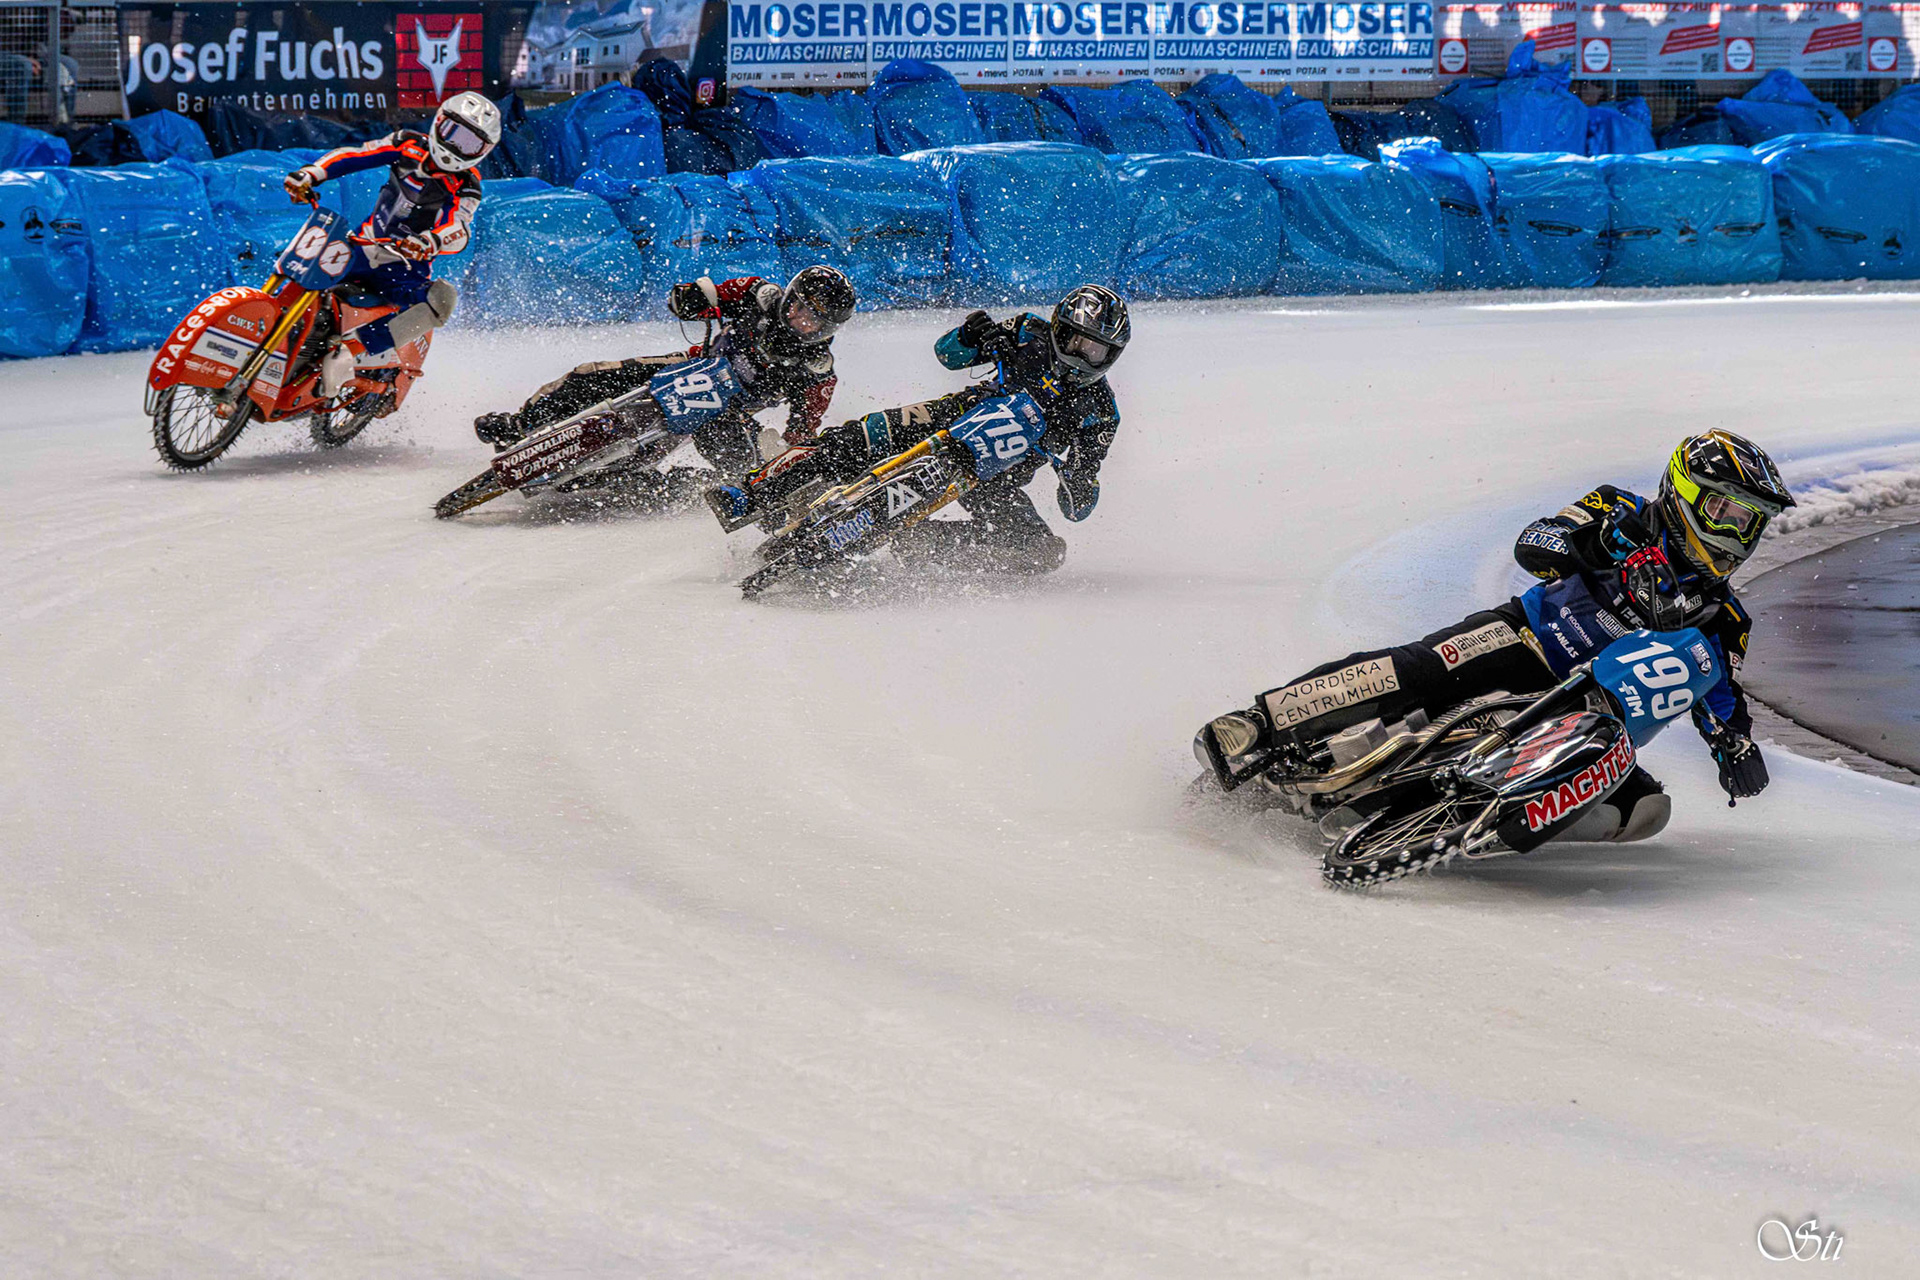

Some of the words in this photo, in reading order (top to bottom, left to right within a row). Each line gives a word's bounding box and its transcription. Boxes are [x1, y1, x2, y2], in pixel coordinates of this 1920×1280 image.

[731, 4, 866, 38] MOSER
[873, 3, 1007, 37] MOSER
[1012, 3, 1148, 37] MOSER
[1156, 2, 1290, 36] MOSER
[1299, 2, 1432, 35] MOSER
[126, 27, 248, 95] Josef
[255, 27, 384, 81] Fuchs
[431, 43, 449, 64] JF
[732, 44, 864, 61] BAUMASCHINEN
[874, 41, 1005, 59] BAUMASCHINEN
[1014, 40, 1148, 59] BAUMASCHINEN
[1157, 41, 1290, 58] BAUMASCHINEN
[1299, 40, 1431, 58] BAUMASCHINEN
[673, 373, 722, 408] 97
[1555, 631, 1579, 659] ANLAS
[1281, 661, 1382, 707] NORDISKA
[1614, 641, 1694, 720] 199
[1275, 676, 1398, 729] CENTRUMHUS
[1617, 681, 1646, 718] FIM
